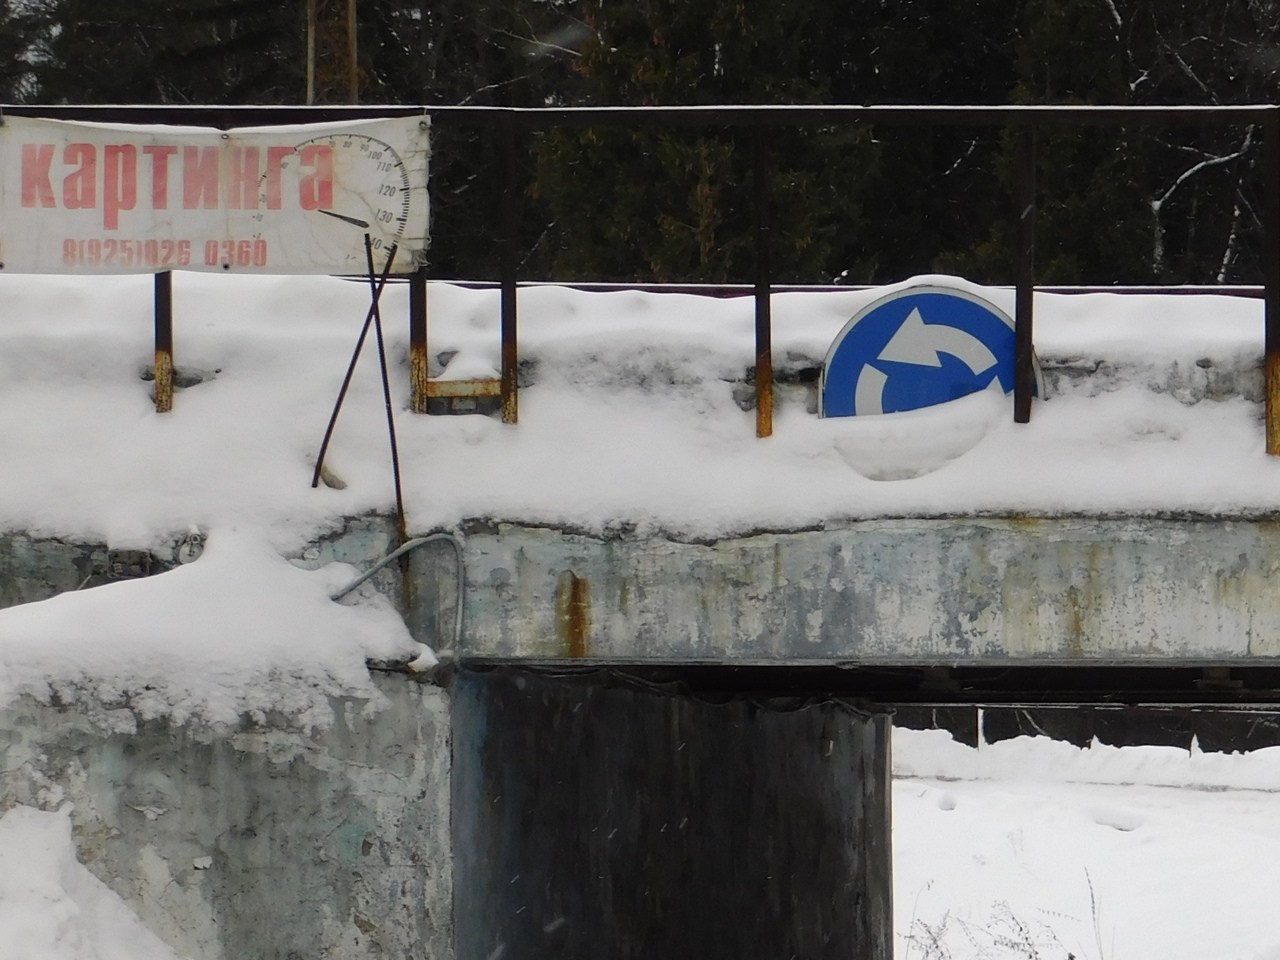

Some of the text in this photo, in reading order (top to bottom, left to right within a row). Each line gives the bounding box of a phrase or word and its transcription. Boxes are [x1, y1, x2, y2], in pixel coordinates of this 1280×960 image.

[367, 150, 383, 161] 100
[376, 161, 392, 173] 110
[21, 143, 333, 230] картинга
[378, 183, 397, 198] 120
[375, 208, 394, 224] 130
[204, 239, 267, 267] 0360
